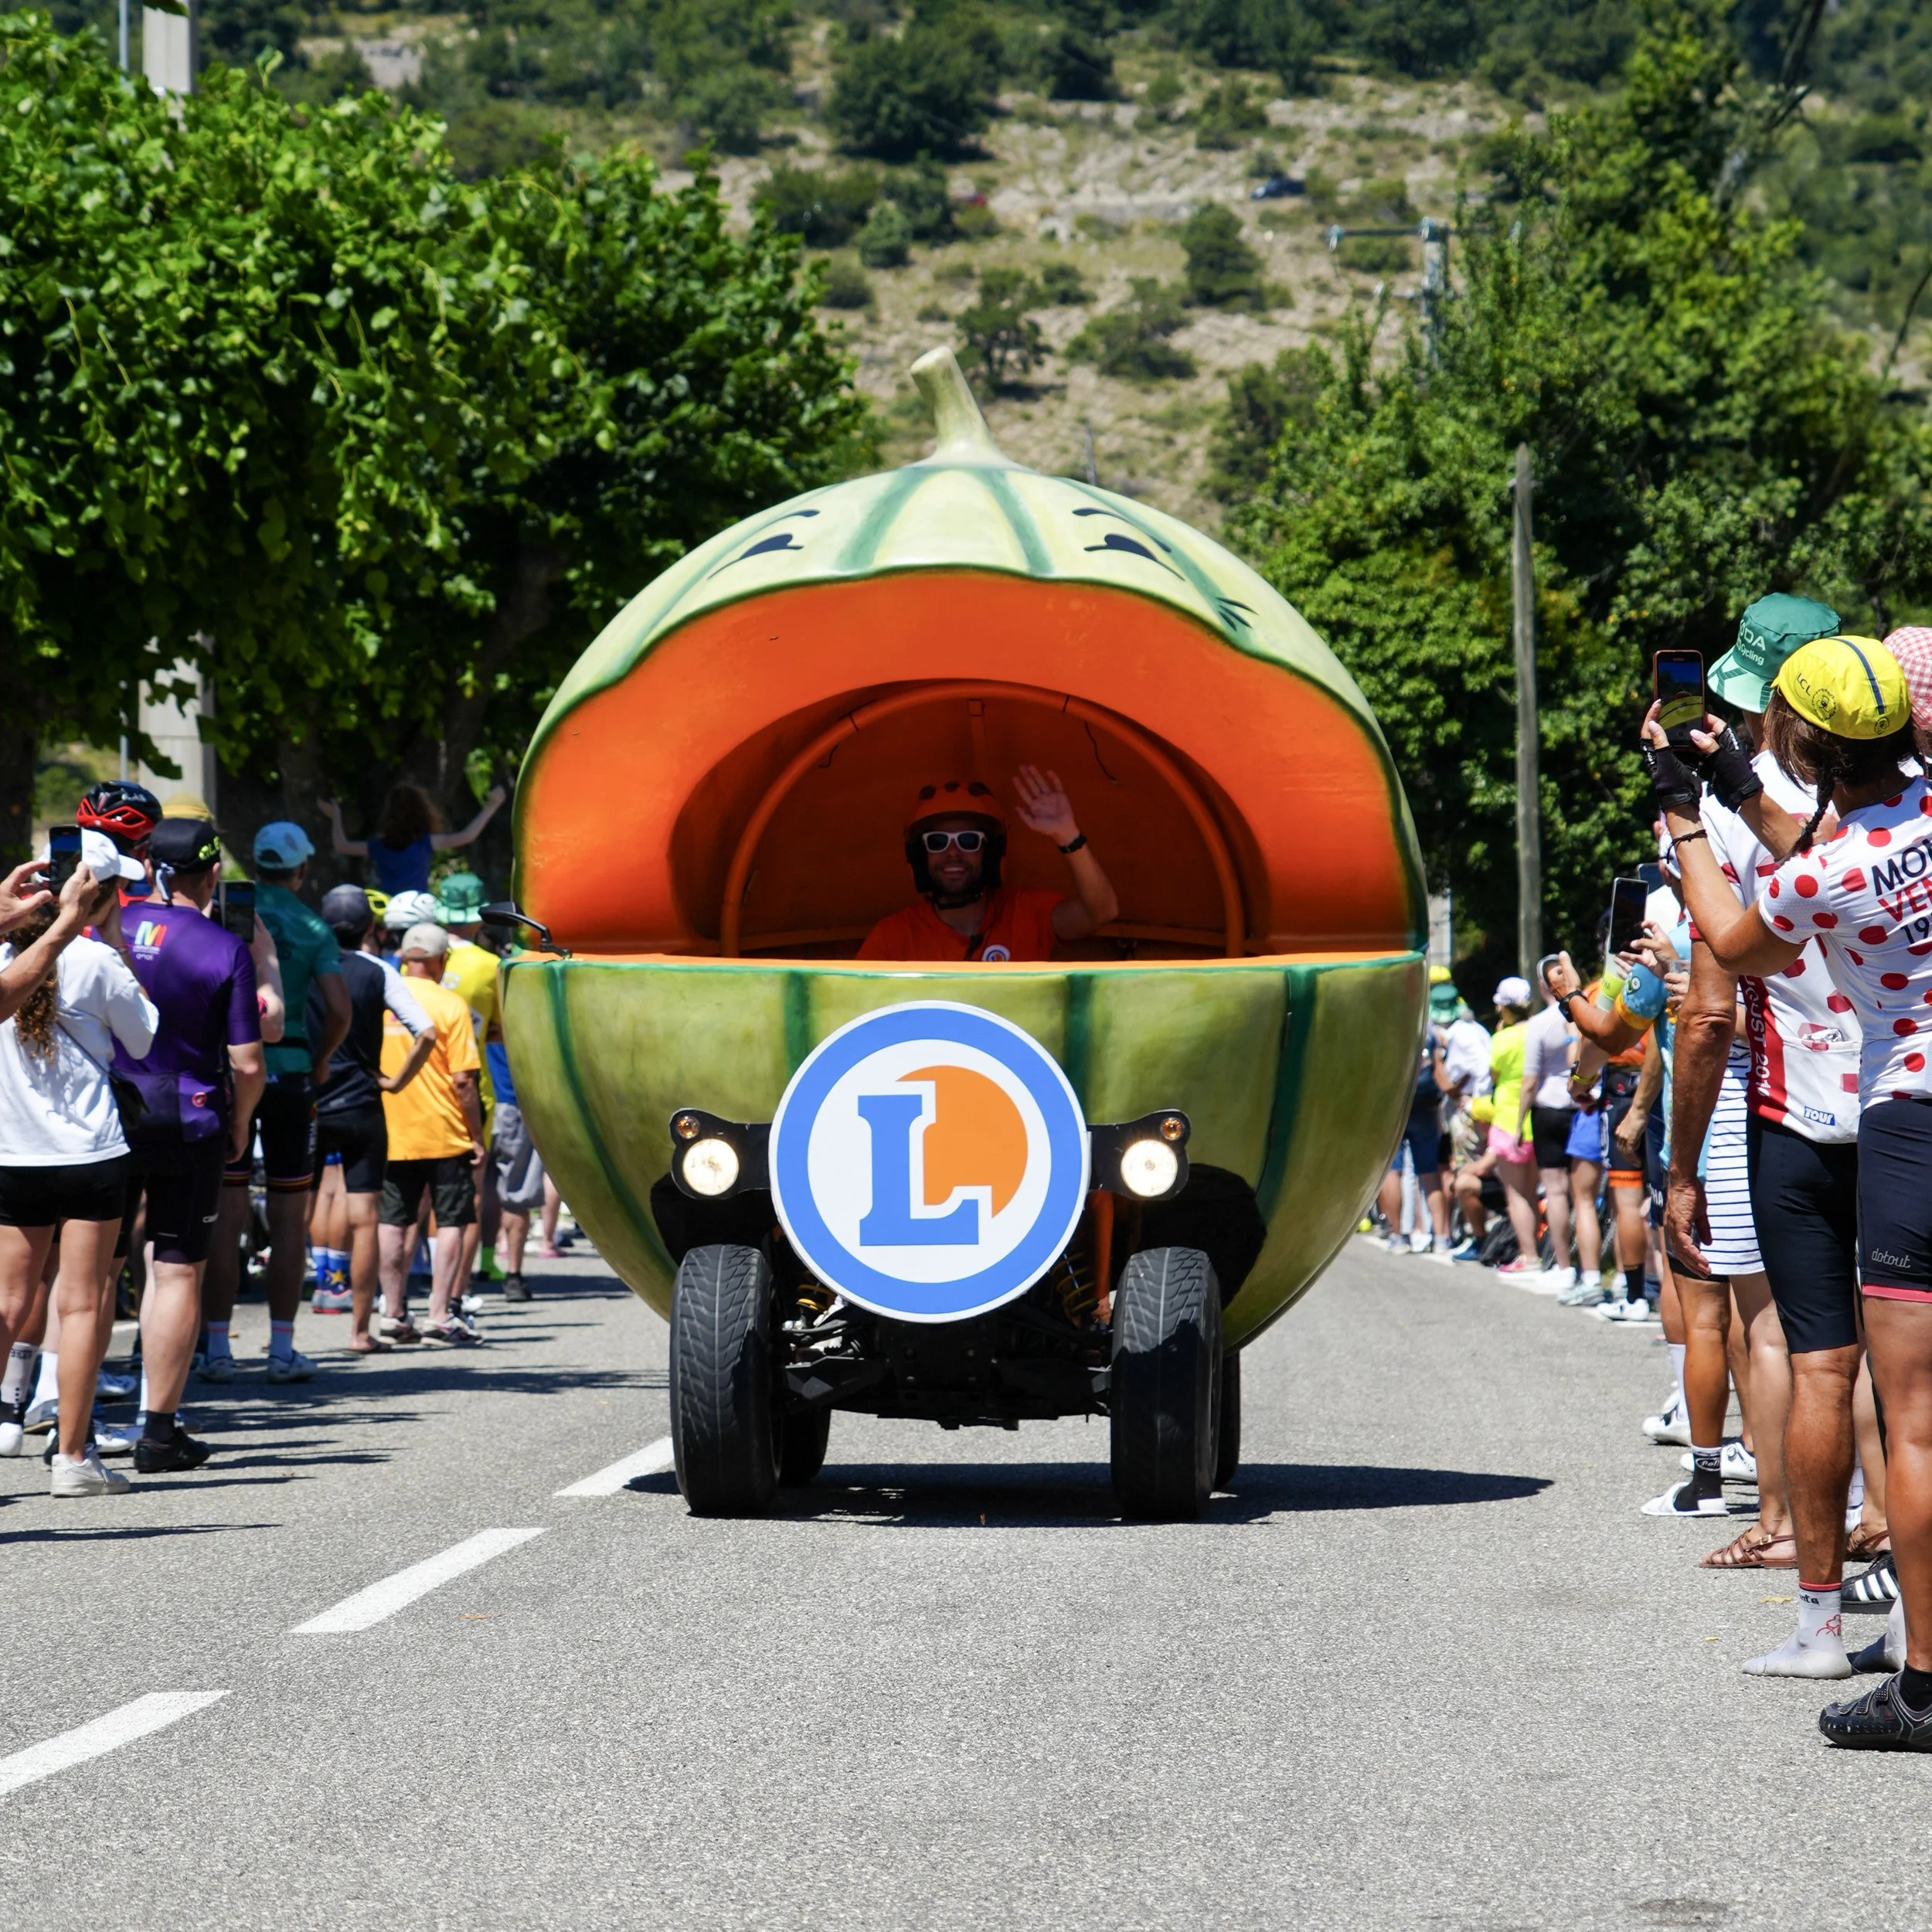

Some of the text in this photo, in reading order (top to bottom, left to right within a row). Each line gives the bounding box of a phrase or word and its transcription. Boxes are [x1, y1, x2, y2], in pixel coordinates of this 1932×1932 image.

[1797, 673, 1811, 696] LCL
[858, 1094, 979, 1247] L
[1872, 1248, 1910, 1268] dotout
